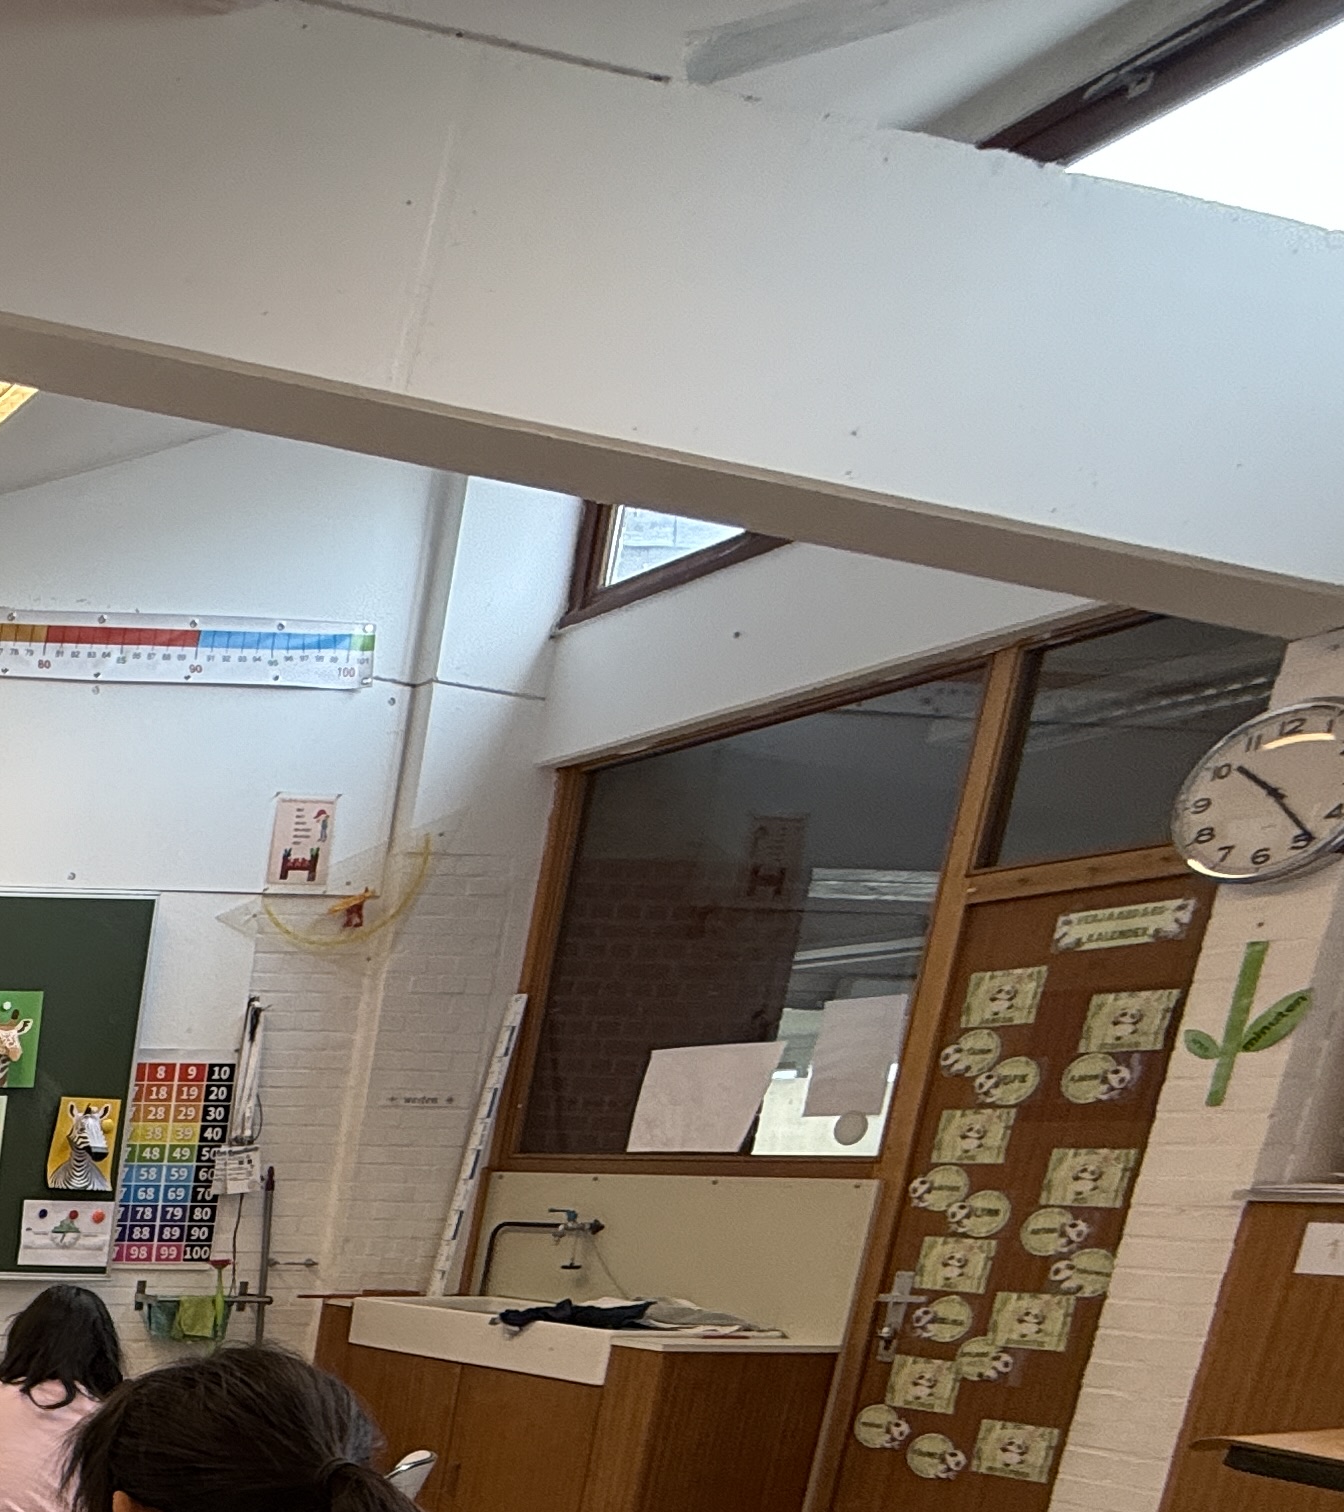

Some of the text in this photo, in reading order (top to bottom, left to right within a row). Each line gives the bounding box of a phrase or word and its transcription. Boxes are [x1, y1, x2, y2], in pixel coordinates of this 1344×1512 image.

[37, 659, 51, 670] 80
[189, 664, 203, 674] 90
[337, 667, 356, 678] 100
[1279, 718, 1306, 736] 12
[1326, 719, 1334, 733] 1
[1245, 734, 1262, 752] 11
[1212, 763, 1232, 781] 10
[1191, 797, 1212, 814] 9
[1324, 803, 1344, 819] 4
[1194, 826, 1216, 844] 8
[1218, 845, 1235, 862] 7
[1251, 848, 1271, 865] 6
[1242, 995, 1309, 1051] minuten
[156, 1066, 230, 1079] 8 9 10
[150, 1086, 227, 1099] 18 19 20
[147, 1107, 224, 1120] 28 29 30
[145, 1126, 221, 1139] 38 39 40
[142, 1147, 160, 1159] 48
[173, 1147, 190, 1159] 49
[139, 1167, 157, 1179] 58
[170, 1167, 187, 1179] 59
[137, 1188, 213, 1200] 68 69 70
[135, 1208, 211, 1220] 78 79 80
[133, 1227, 208, 1240] 88 89 90
[130, 1246, 210, 1259] 98 99 100
